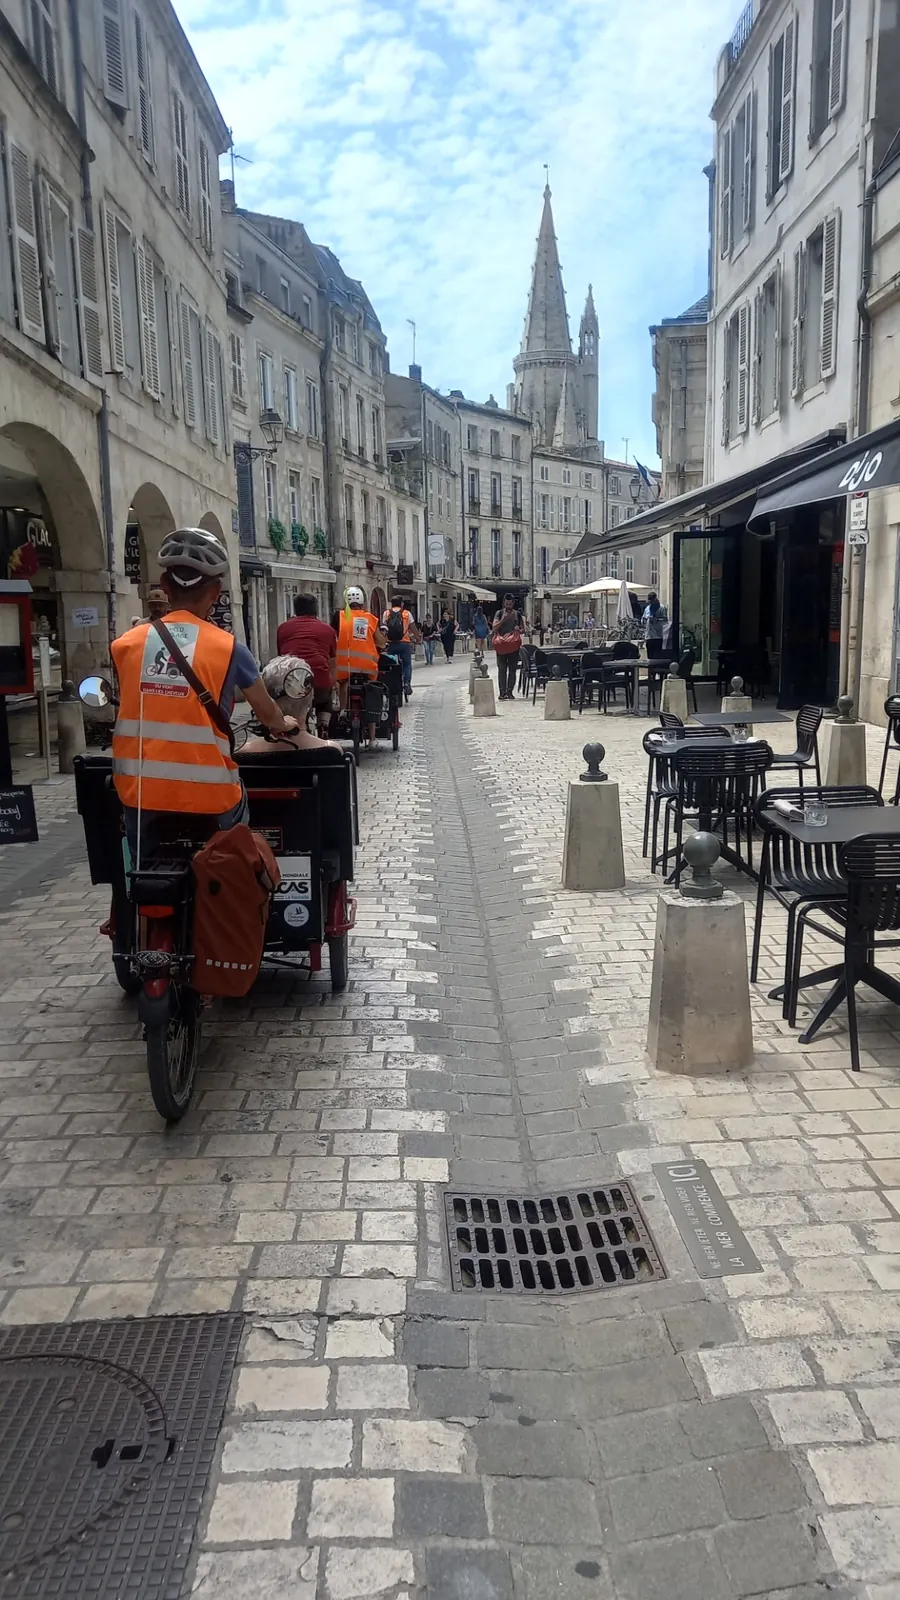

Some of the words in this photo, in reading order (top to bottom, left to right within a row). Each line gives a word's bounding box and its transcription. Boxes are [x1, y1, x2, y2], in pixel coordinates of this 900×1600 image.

[666, 1164, 701, 1183] ICI
[692, 1184, 724, 1226] COMMENCE
[694, 1228, 711, 1245] JETER
[715, 1231, 736, 1249] MER
[703, 1245, 719, 1260] RIEN
[709, 1260, 722, 1269] NE
[729, 1257, 745, 1267] LA
